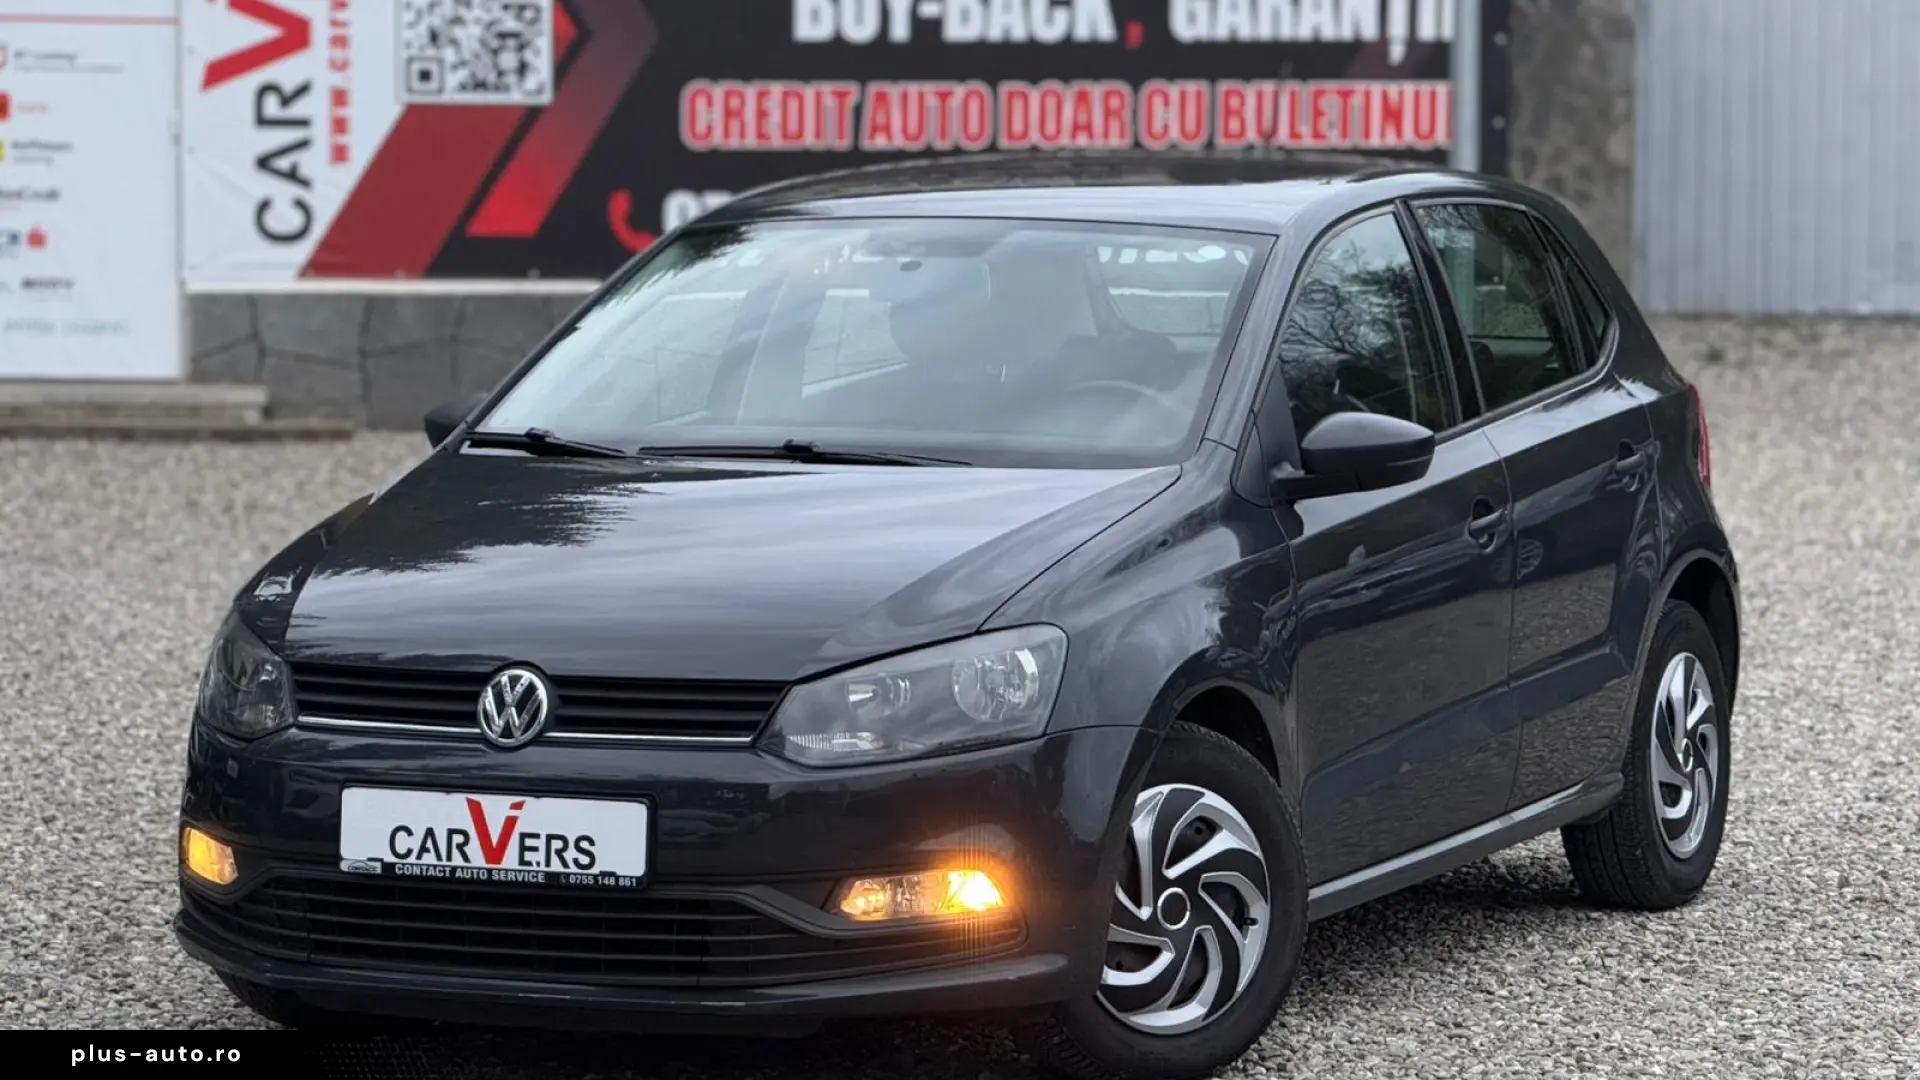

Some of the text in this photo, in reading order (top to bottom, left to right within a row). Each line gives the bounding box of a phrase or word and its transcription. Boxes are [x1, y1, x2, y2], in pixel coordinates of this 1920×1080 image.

[682, 81, 857, 150] CREDIT
[862, 81, 993, 150] AUTO
[999, 81, 1134, 150] DOAR
[1139, 81, 1208, 150] CU
[388, 796, 597, 871] CARVERS
[395, 863, 451, 878] CONTACT
[455, 867, 487, 880] AUTO
[491, 869, 546, 884] SERVICE
[569, 874, 594, 885] 0755
[597, 875, 616, 886] 148
[618, 876, 637, 887] 861
